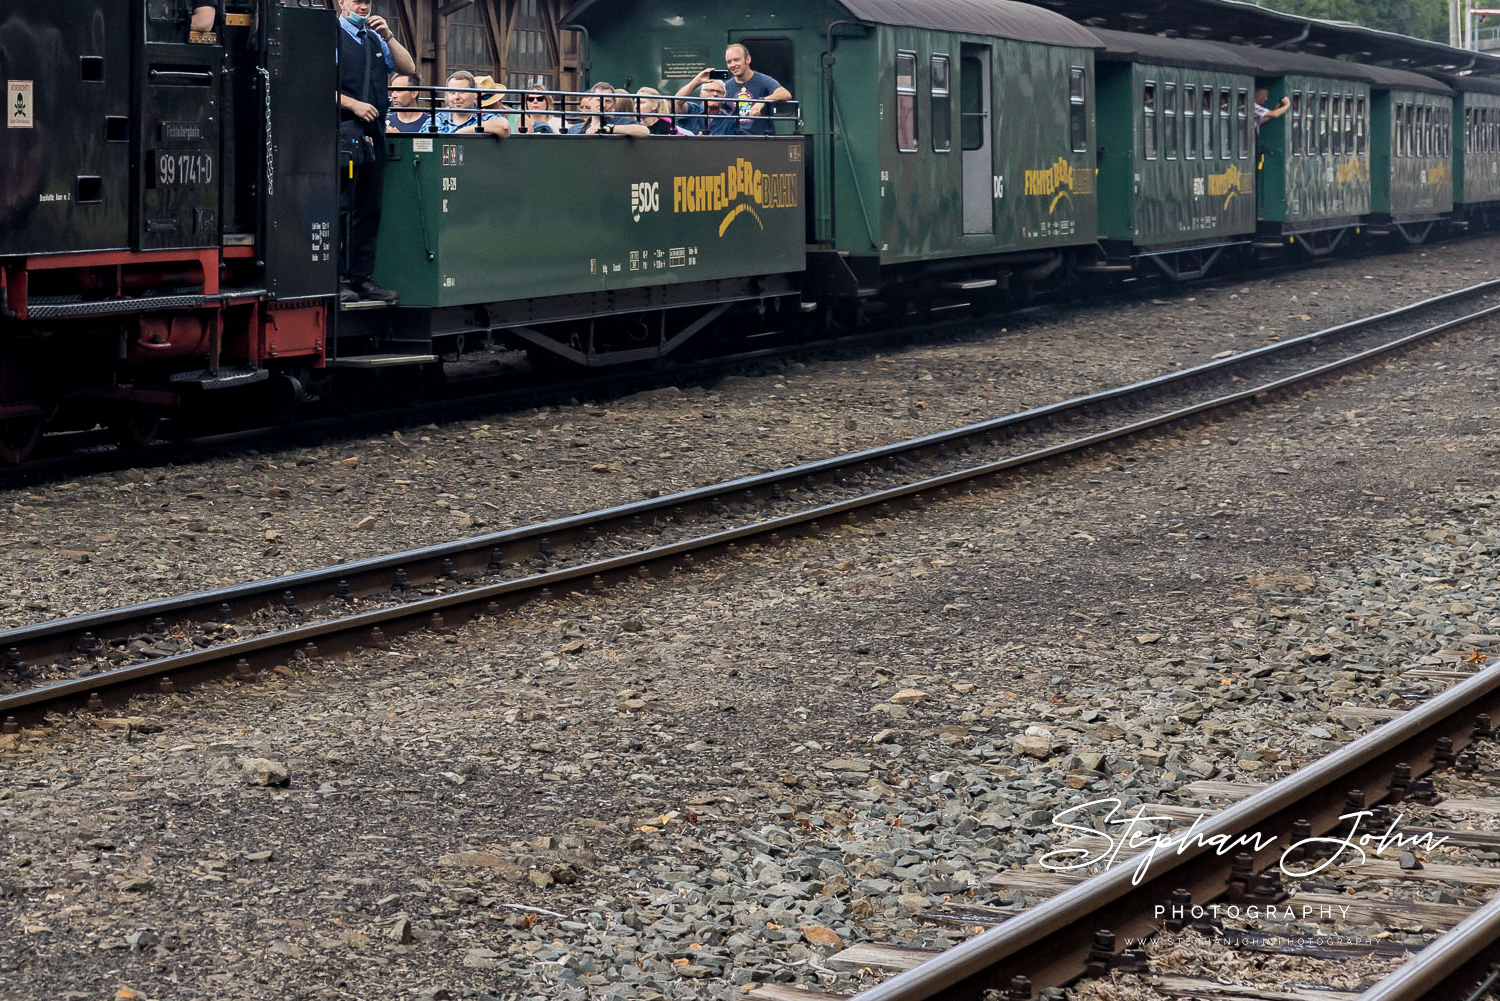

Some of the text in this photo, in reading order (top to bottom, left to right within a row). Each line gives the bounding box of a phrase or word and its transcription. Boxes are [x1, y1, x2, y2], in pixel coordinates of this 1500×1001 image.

[160, 154, 212, 184] 99 1741-0
[638, 181, 660, 213] SDG
[993, 175, 1003, 198] DG
